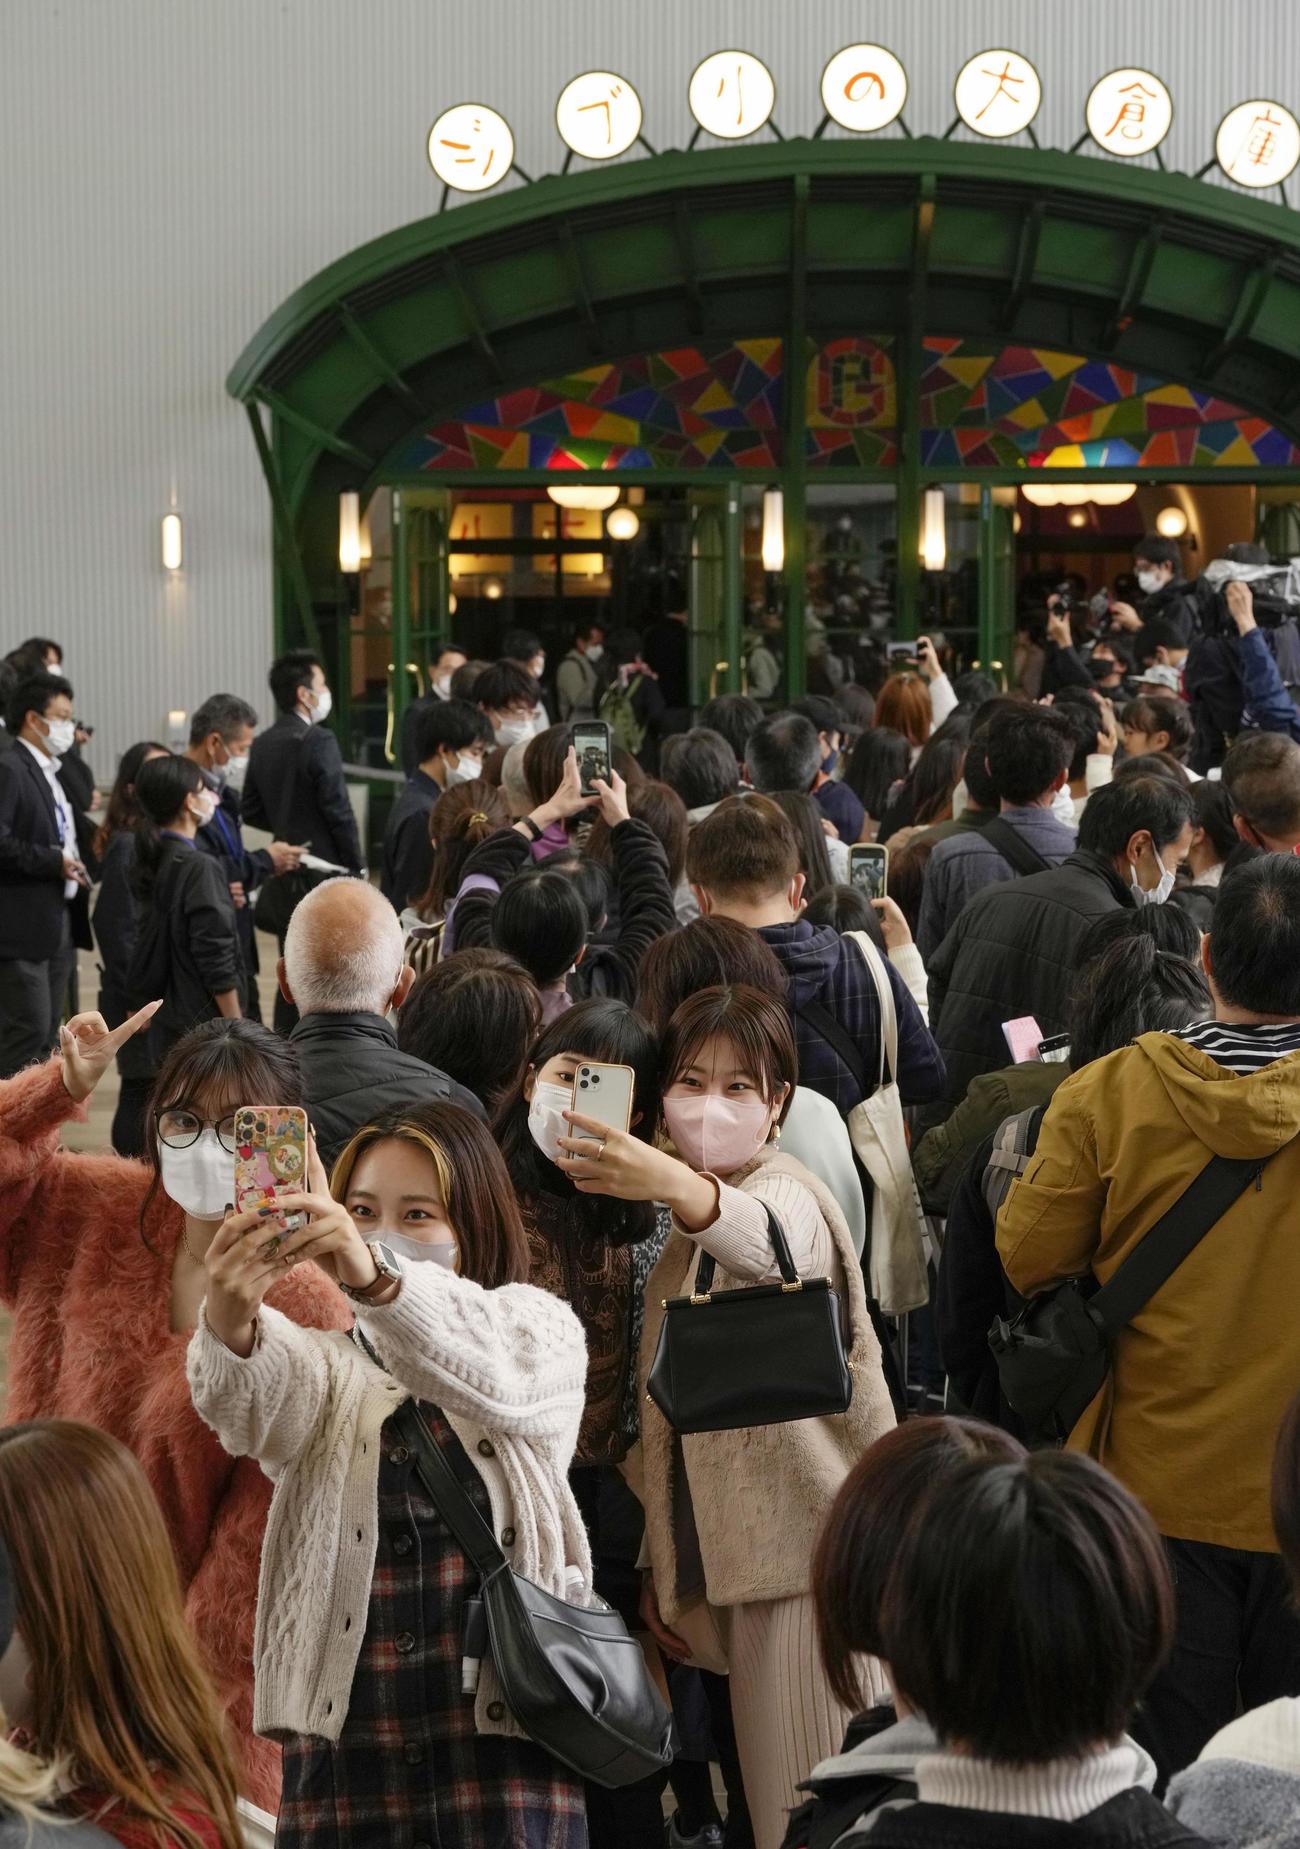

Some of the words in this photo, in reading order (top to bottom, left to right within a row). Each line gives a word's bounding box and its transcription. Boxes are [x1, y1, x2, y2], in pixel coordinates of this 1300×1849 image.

[439, 61, 1282, 177] ジブリの大倉庫
